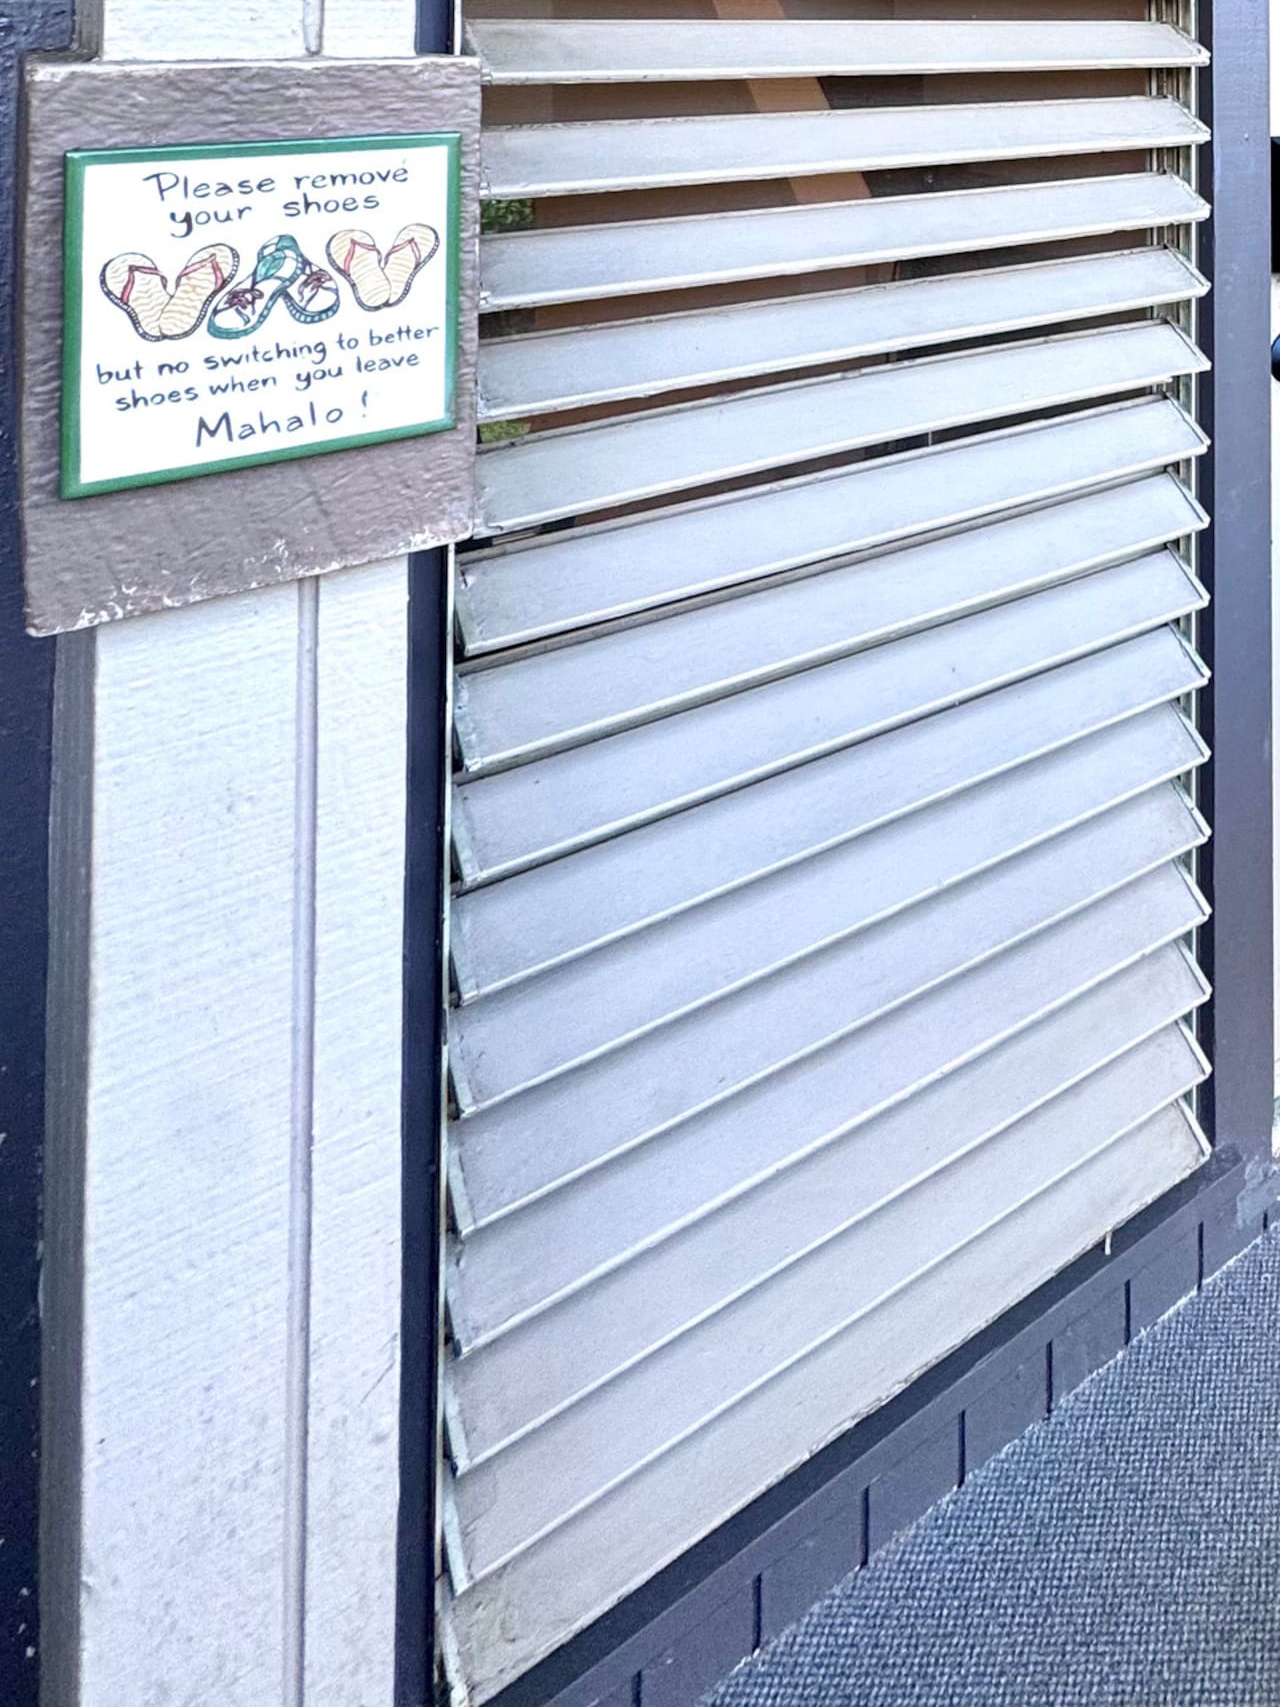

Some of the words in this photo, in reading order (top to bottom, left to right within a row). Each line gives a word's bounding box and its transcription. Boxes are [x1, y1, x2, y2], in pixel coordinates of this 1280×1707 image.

[143, 171, 275, 201] Please
[294, 165, 409, 190] remove
[169, 204, 251, 238] your
[283, 193, 380, 218] shoes
[96, 363, 143, 384] but
[158, 359, 189, 376] no
[203, 340, 327, 369] switching
[336, 332, 359, 350] to
[369, 324, 439, 347] better
[115, 384, 198, 411] shoes
[209, 376, 277, 396] when
[295, 365, 343, 391] you
[356, 352, 420, 373] leave
